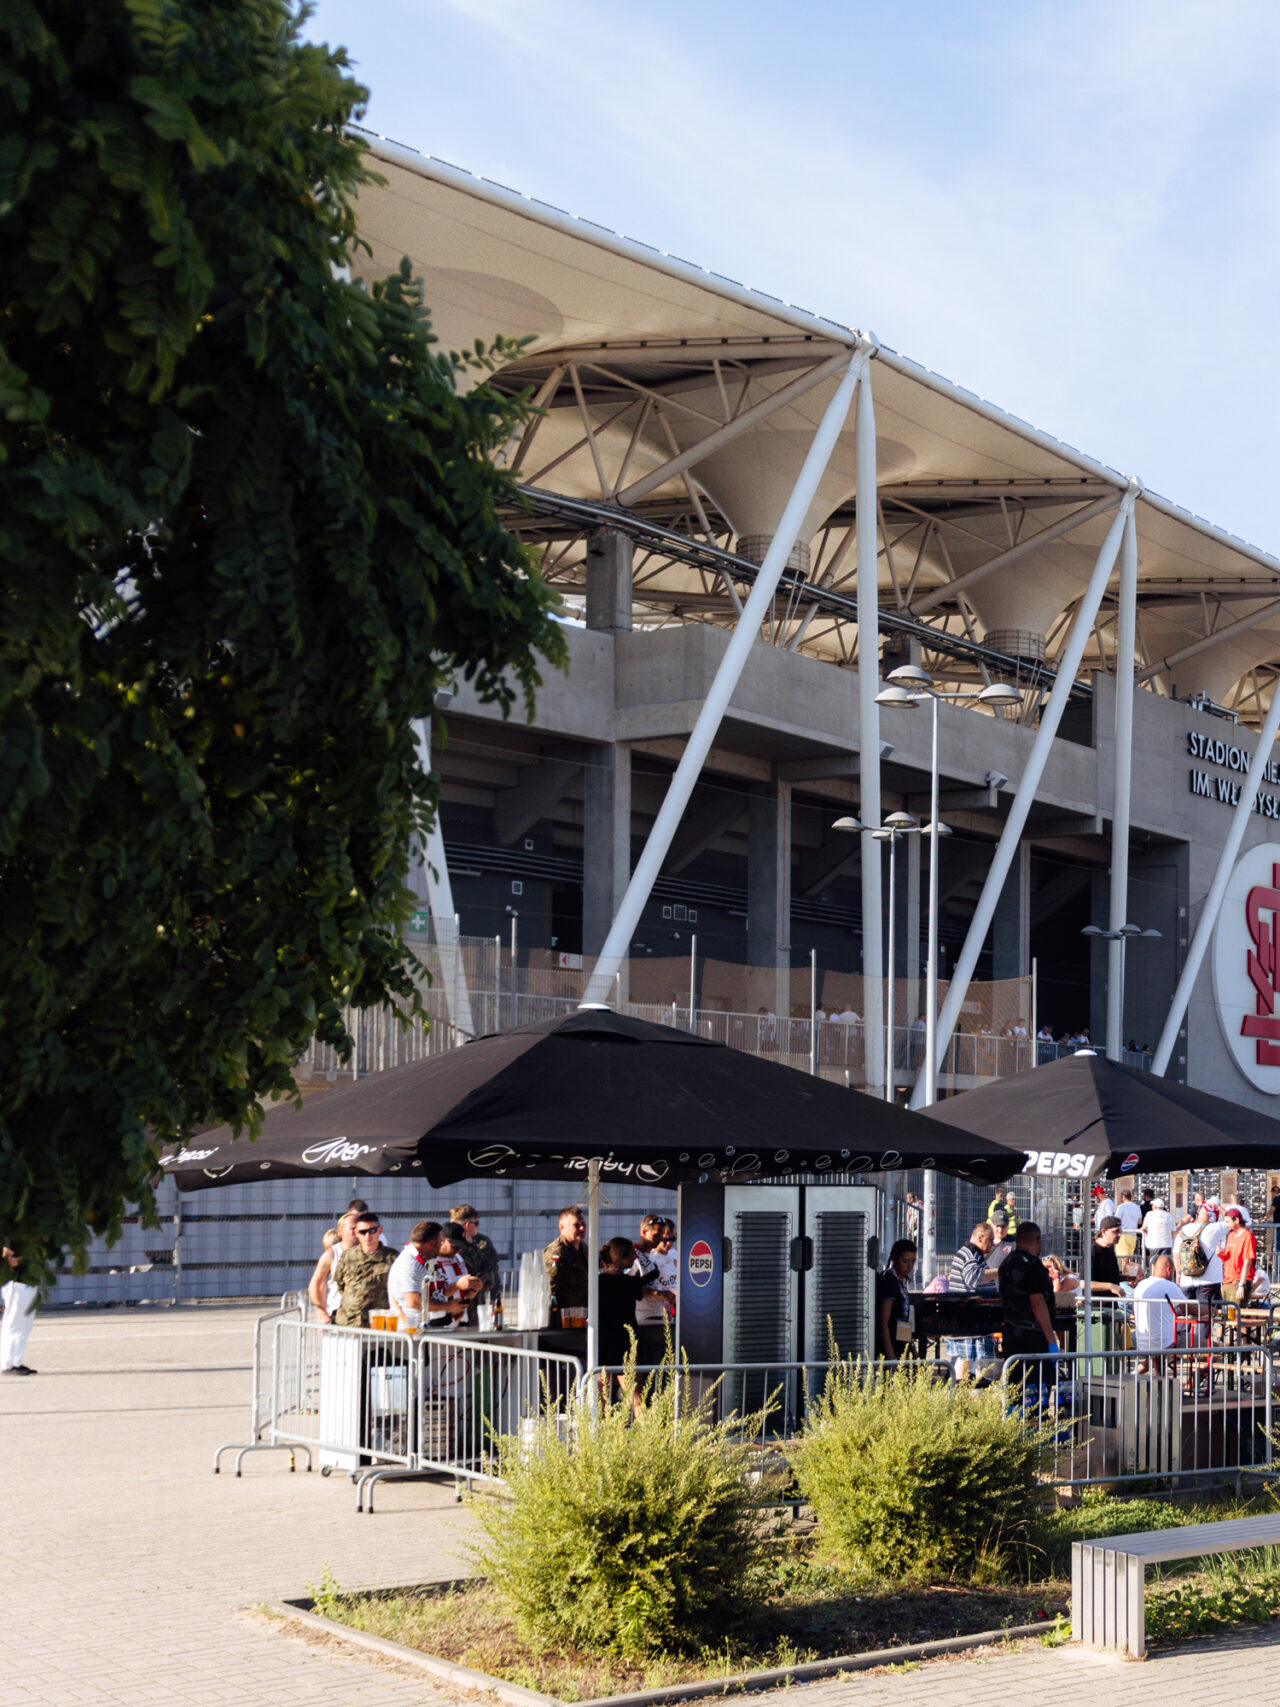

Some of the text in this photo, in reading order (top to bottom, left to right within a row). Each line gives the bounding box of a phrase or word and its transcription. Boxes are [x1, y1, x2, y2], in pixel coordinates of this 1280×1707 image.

[1189, 731, 1250, 773] STADION
[1191, 769, 1214, 798] IM.
[1021, 1150, 1096, 1178] PEPSI
[690, 1258, 712, 1269] PEPSI
